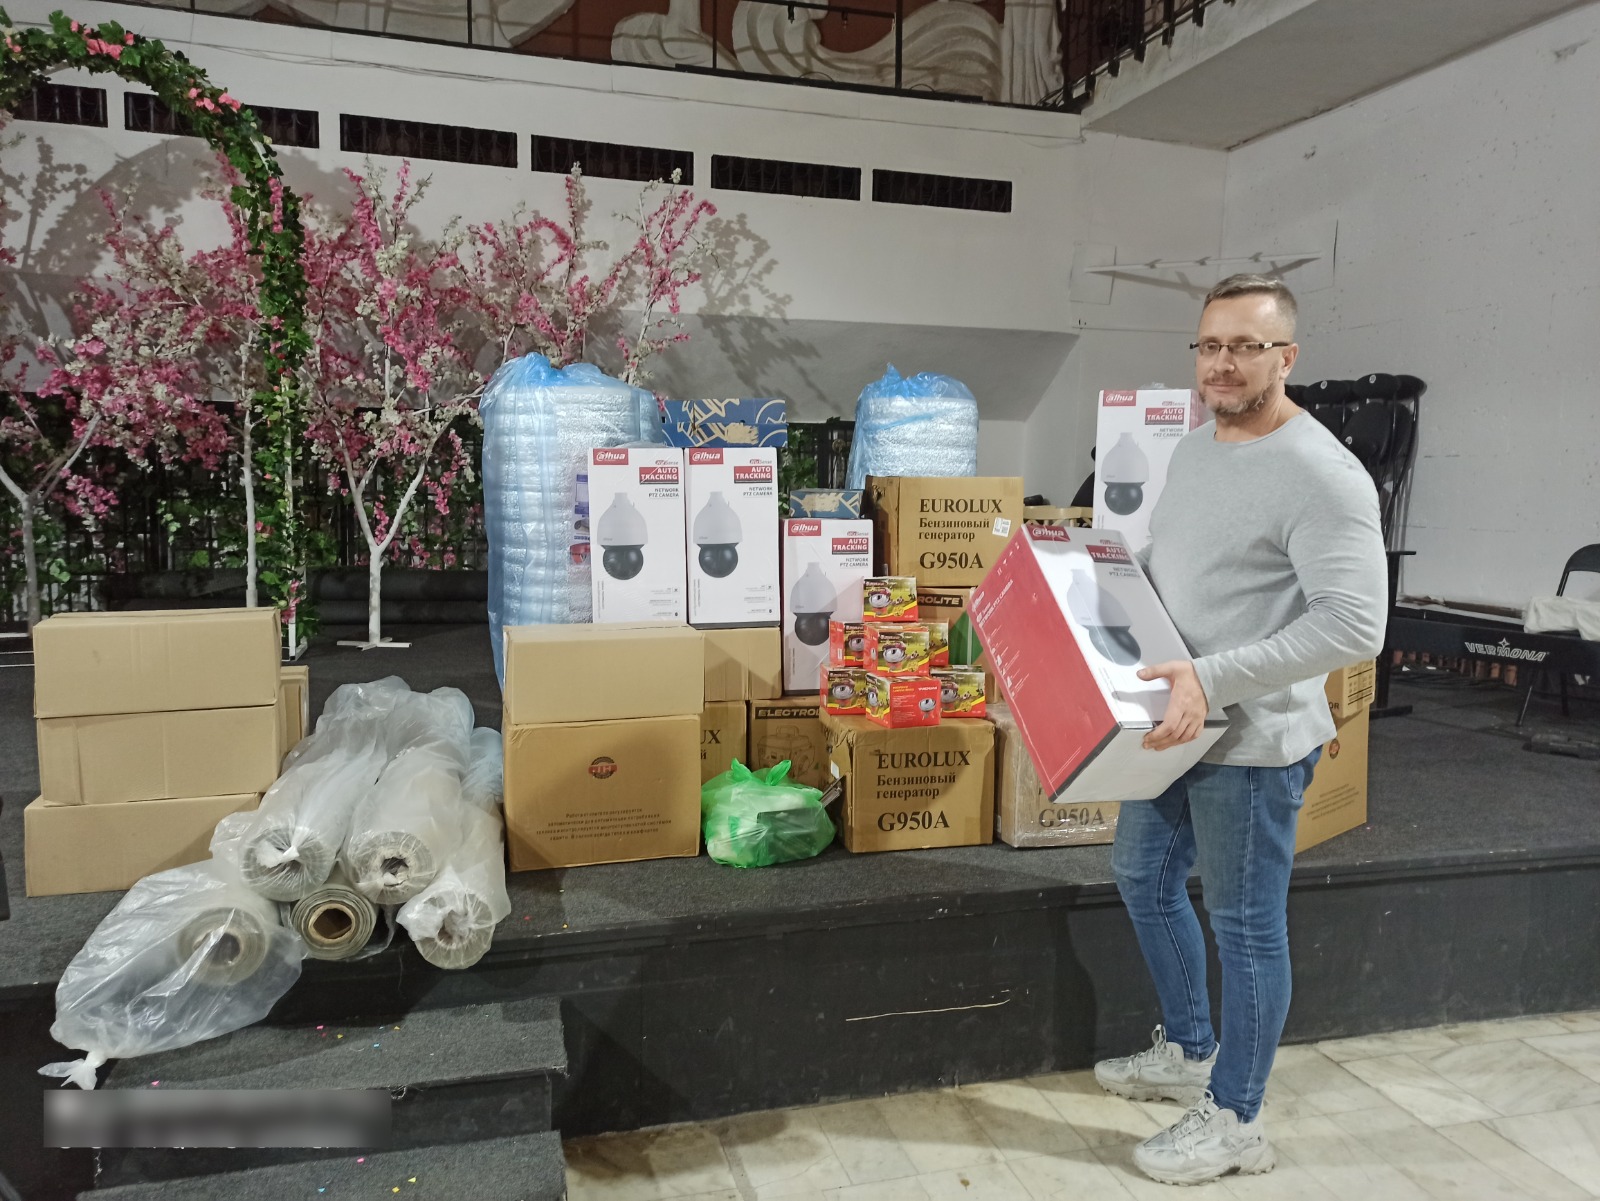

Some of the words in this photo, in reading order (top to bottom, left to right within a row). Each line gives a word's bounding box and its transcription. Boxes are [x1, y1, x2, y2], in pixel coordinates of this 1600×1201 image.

[919, 498, 1002, 513] EUROLUX
[920, 517, 990, 528] Бензиновый
[919, 531, 975, 542] генератор
[919, 551, 984, 569] G950A
[1464, 641, 1547, 662] VERMONA
[877, 750, 971, 769] EUROLUX
[877, 772, 956, 786] Бензиновый
[876, 788, 940, 801] генератор
[877, 810, 950, 832] G950A
[1039, 807, 1105, 827] G950A
